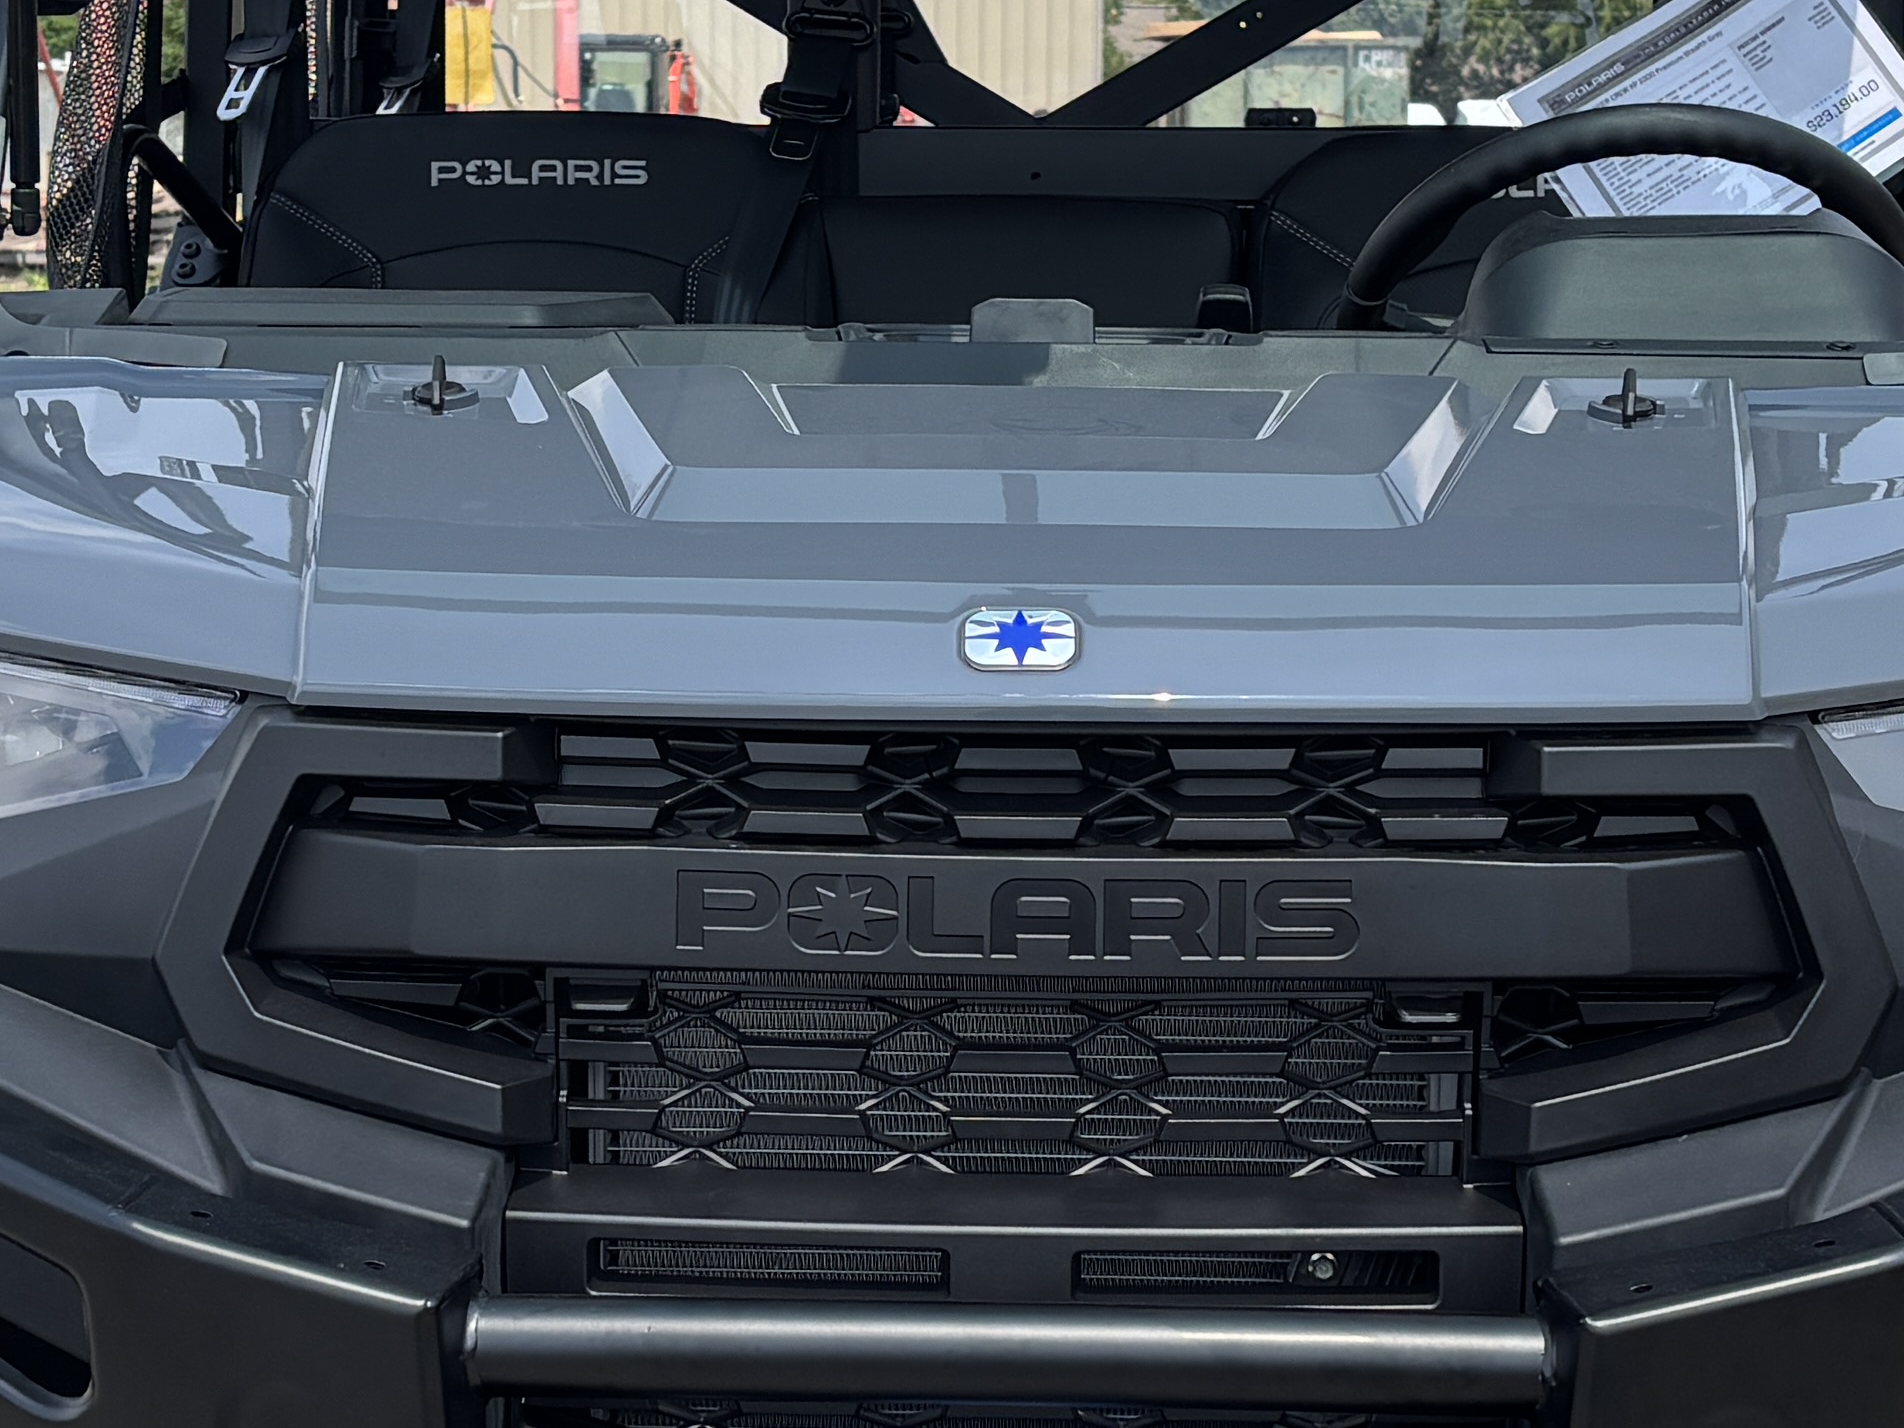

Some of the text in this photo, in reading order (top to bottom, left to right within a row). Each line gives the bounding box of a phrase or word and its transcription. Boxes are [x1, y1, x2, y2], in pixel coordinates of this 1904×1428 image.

[1563, 60, 1626, 104] POLARIS
[430, 158, 649, 188] POLARIS
[675, 868, 1362, 963] POLARIS
